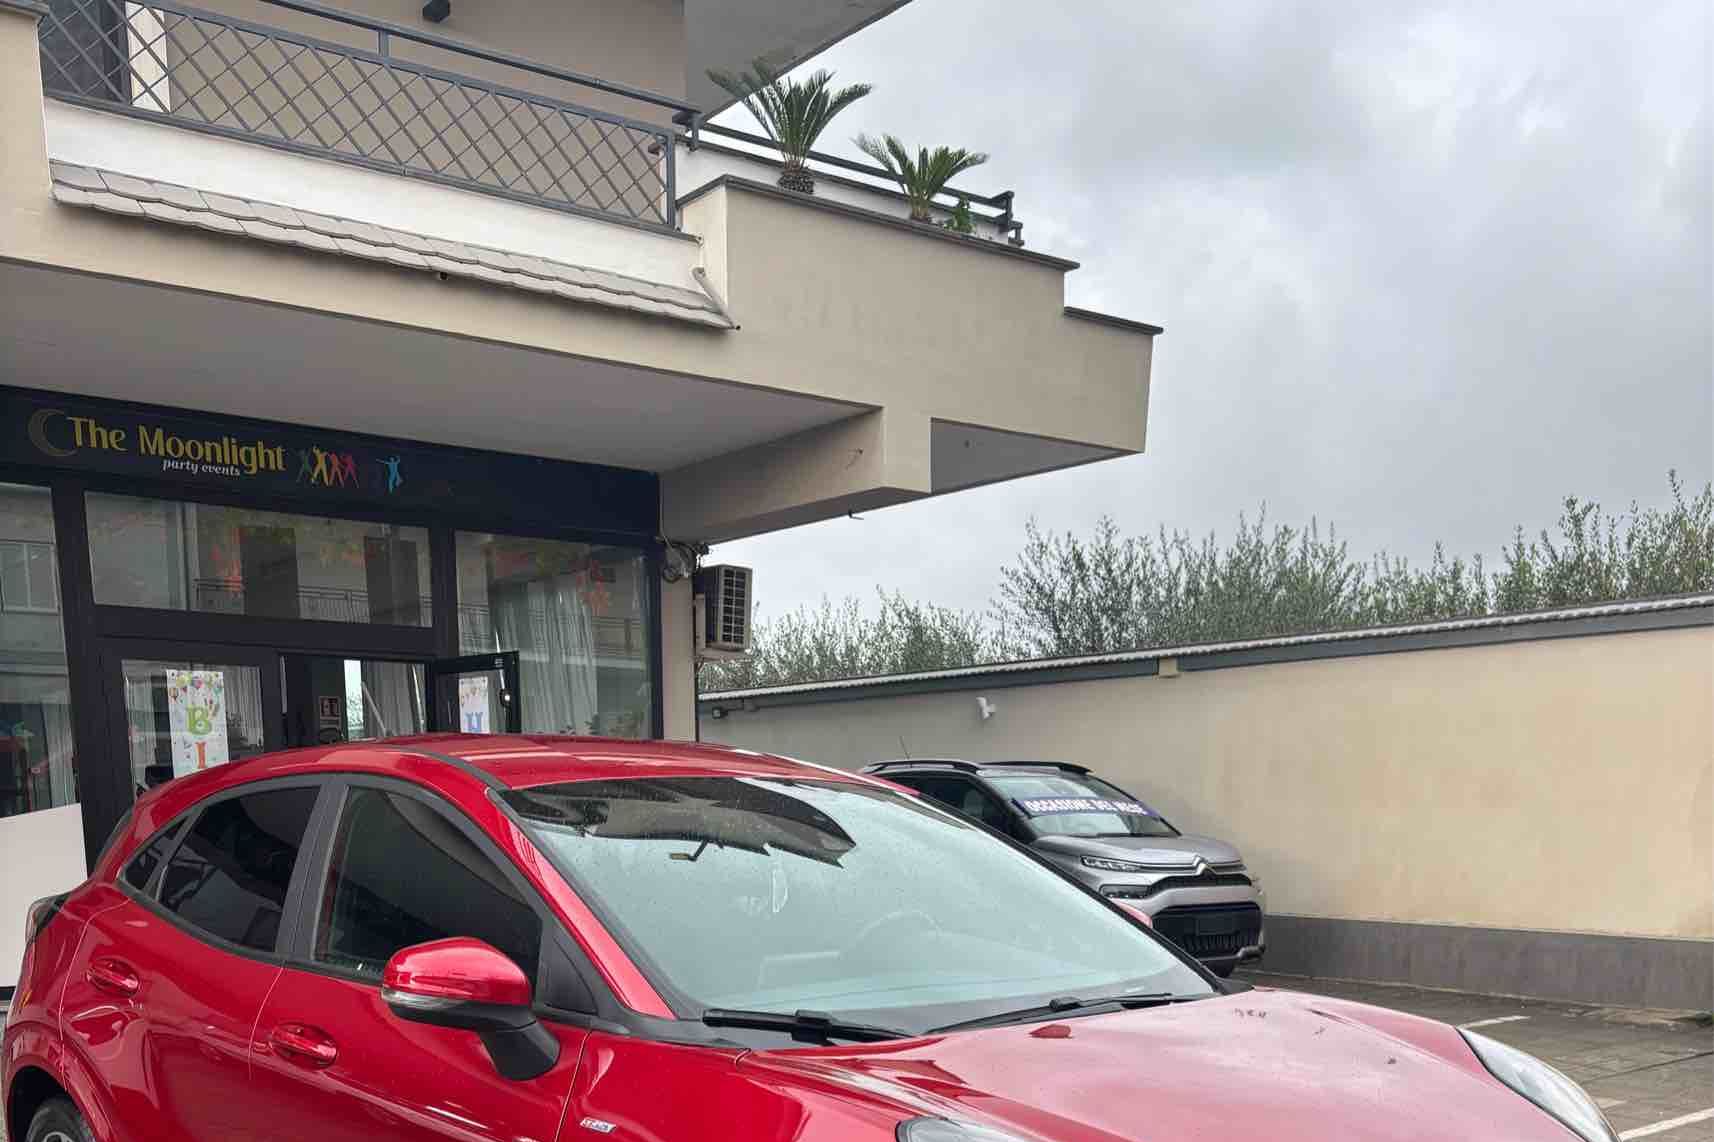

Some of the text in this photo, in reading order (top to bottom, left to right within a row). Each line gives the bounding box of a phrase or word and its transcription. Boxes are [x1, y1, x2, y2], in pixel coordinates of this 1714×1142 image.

[67, 416, 286, 474] The Moonlight
[162, 459, 240, 477] party events
